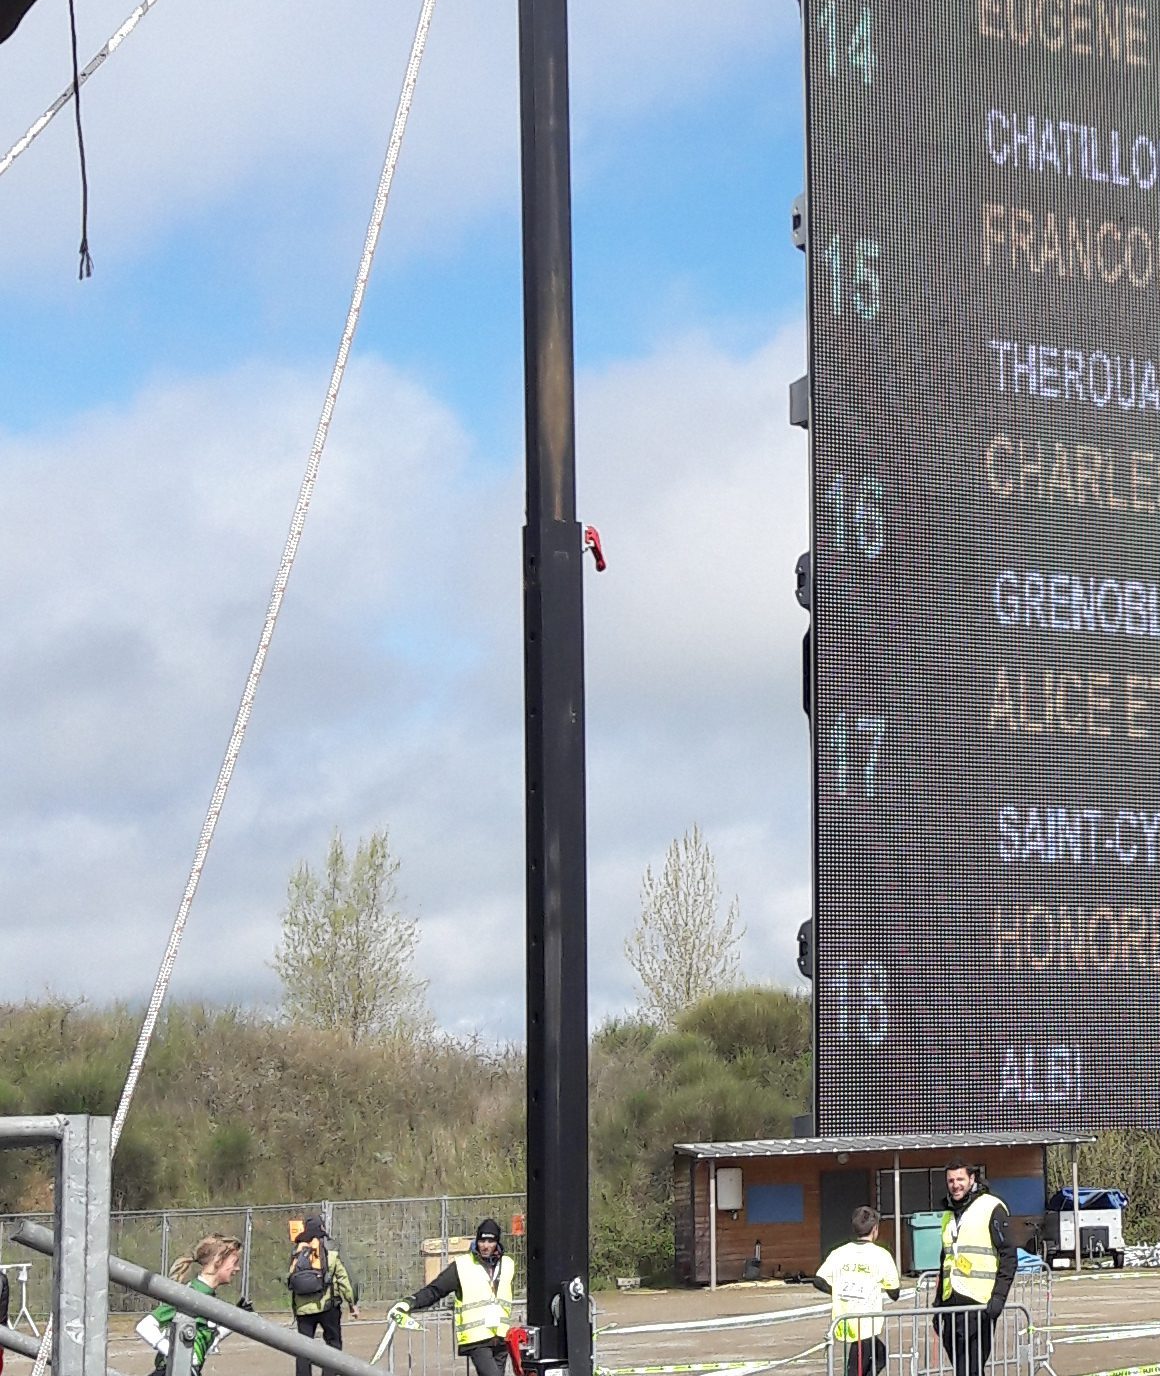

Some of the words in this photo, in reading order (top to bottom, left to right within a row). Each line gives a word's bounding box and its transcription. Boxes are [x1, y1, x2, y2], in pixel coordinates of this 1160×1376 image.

[817, 0, 878, 86] 14
[824, 234, 882, 321] 15
[826, 471, 885, 559] 16
[989, 668, 1111, 736] ALICE
[829, 714, 886, 798] 17
[831, 959, 889, 1043] 18
[999, 1045, 1082, 1102] ALBI
